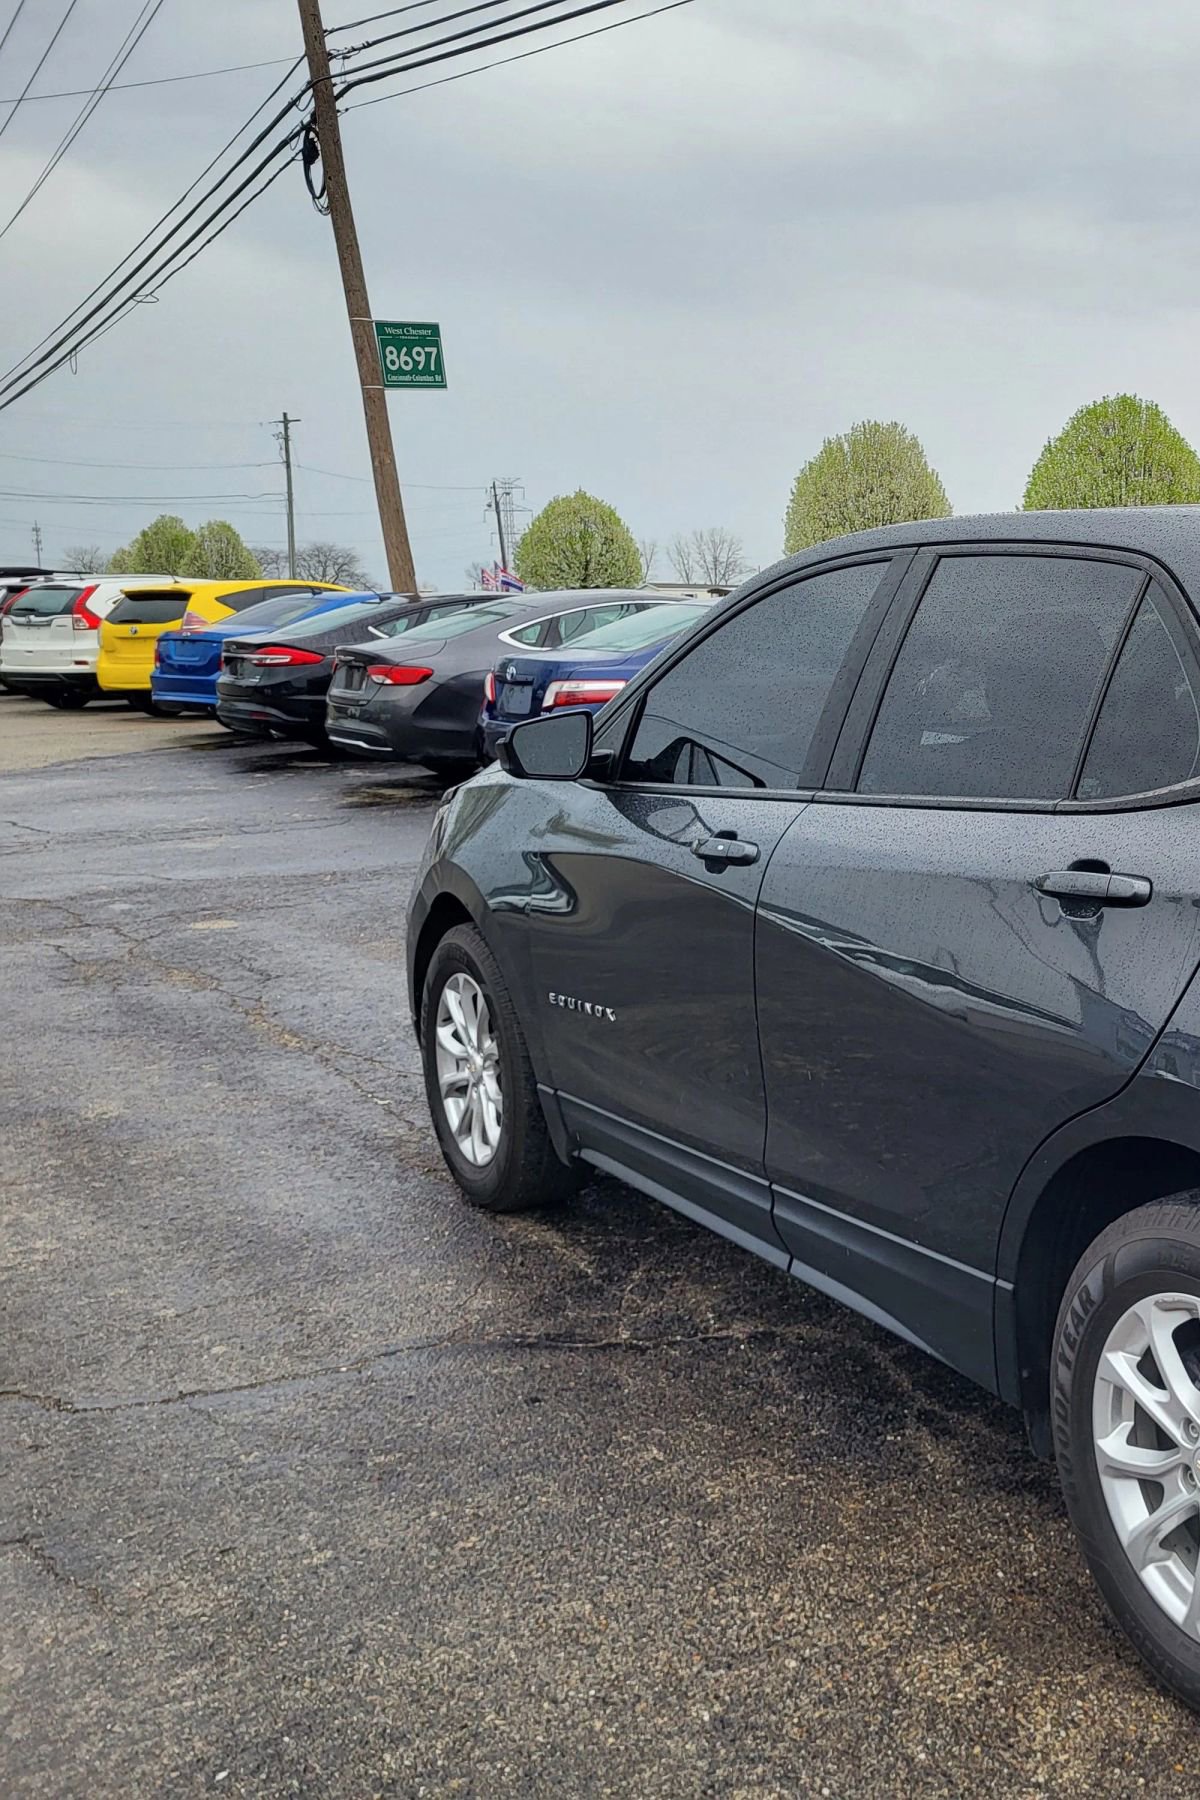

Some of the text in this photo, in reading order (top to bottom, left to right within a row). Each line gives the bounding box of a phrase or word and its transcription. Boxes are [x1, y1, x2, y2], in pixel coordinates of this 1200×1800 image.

[404, 327, 432, 335] Chester
[385, 346, 437, 371] 8697
[549, 992, 616, 1021] EQUINOX
